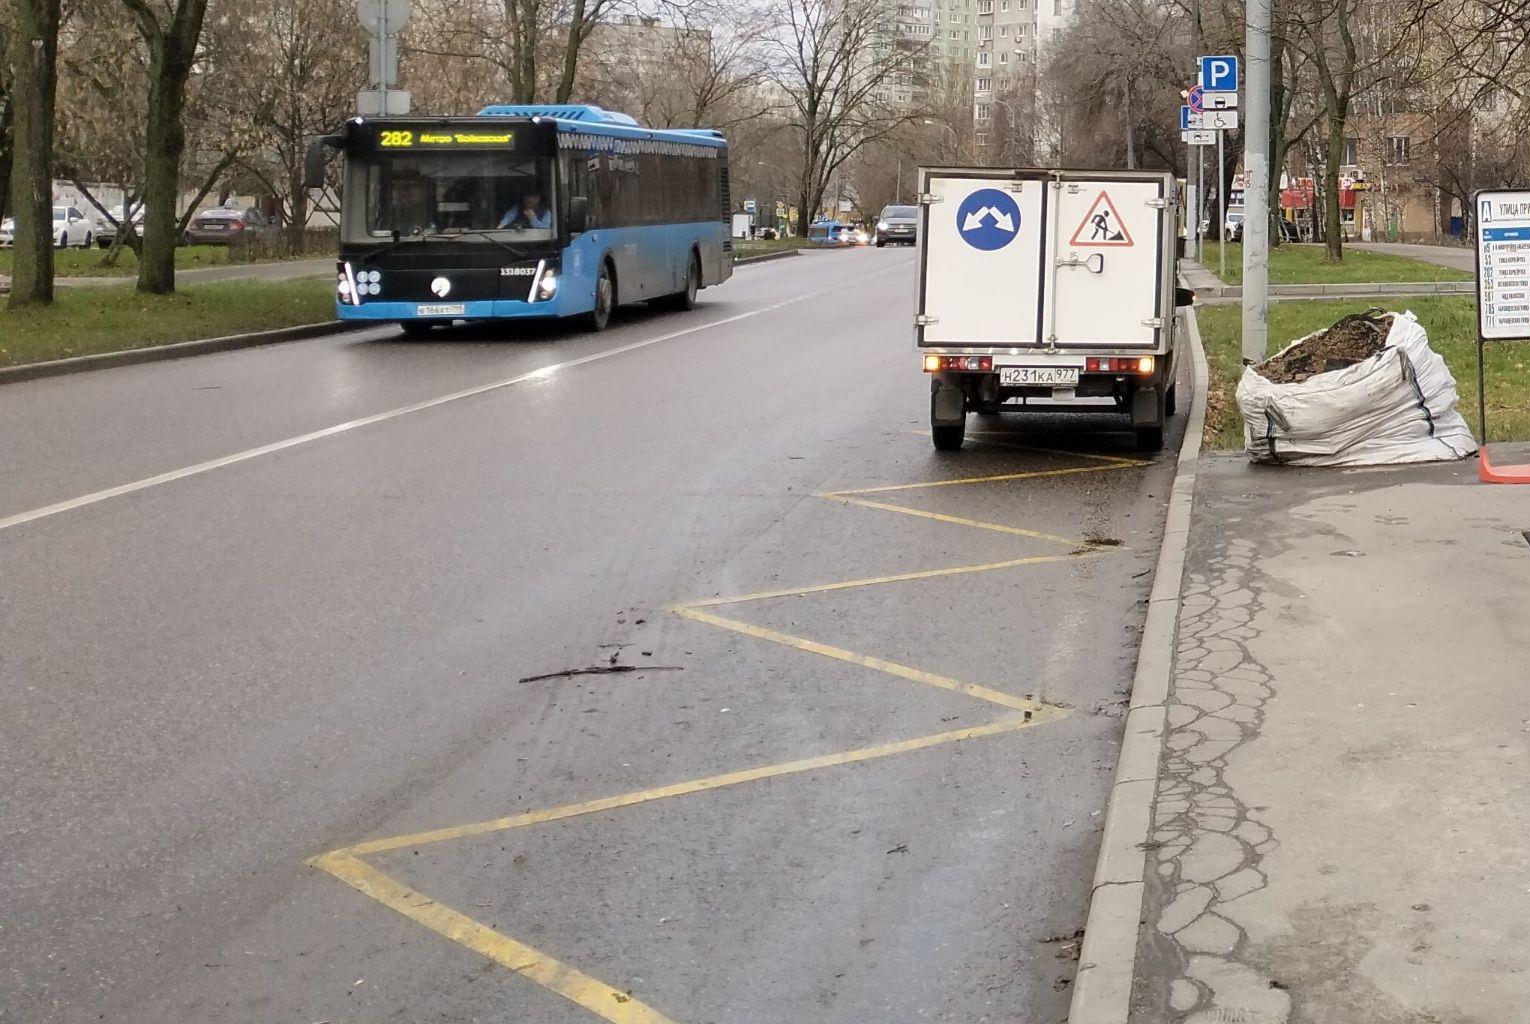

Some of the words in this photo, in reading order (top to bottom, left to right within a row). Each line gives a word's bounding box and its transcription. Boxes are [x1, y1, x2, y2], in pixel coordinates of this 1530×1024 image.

[1210, 60, 1230, 87] P
[380, 131, 413, 147] 282
[1499, 203, 1519, 216] УЛИЦА
[1004, 369, 1053, 382] Н231КА
[1056, 369, 1075, 378] 977
